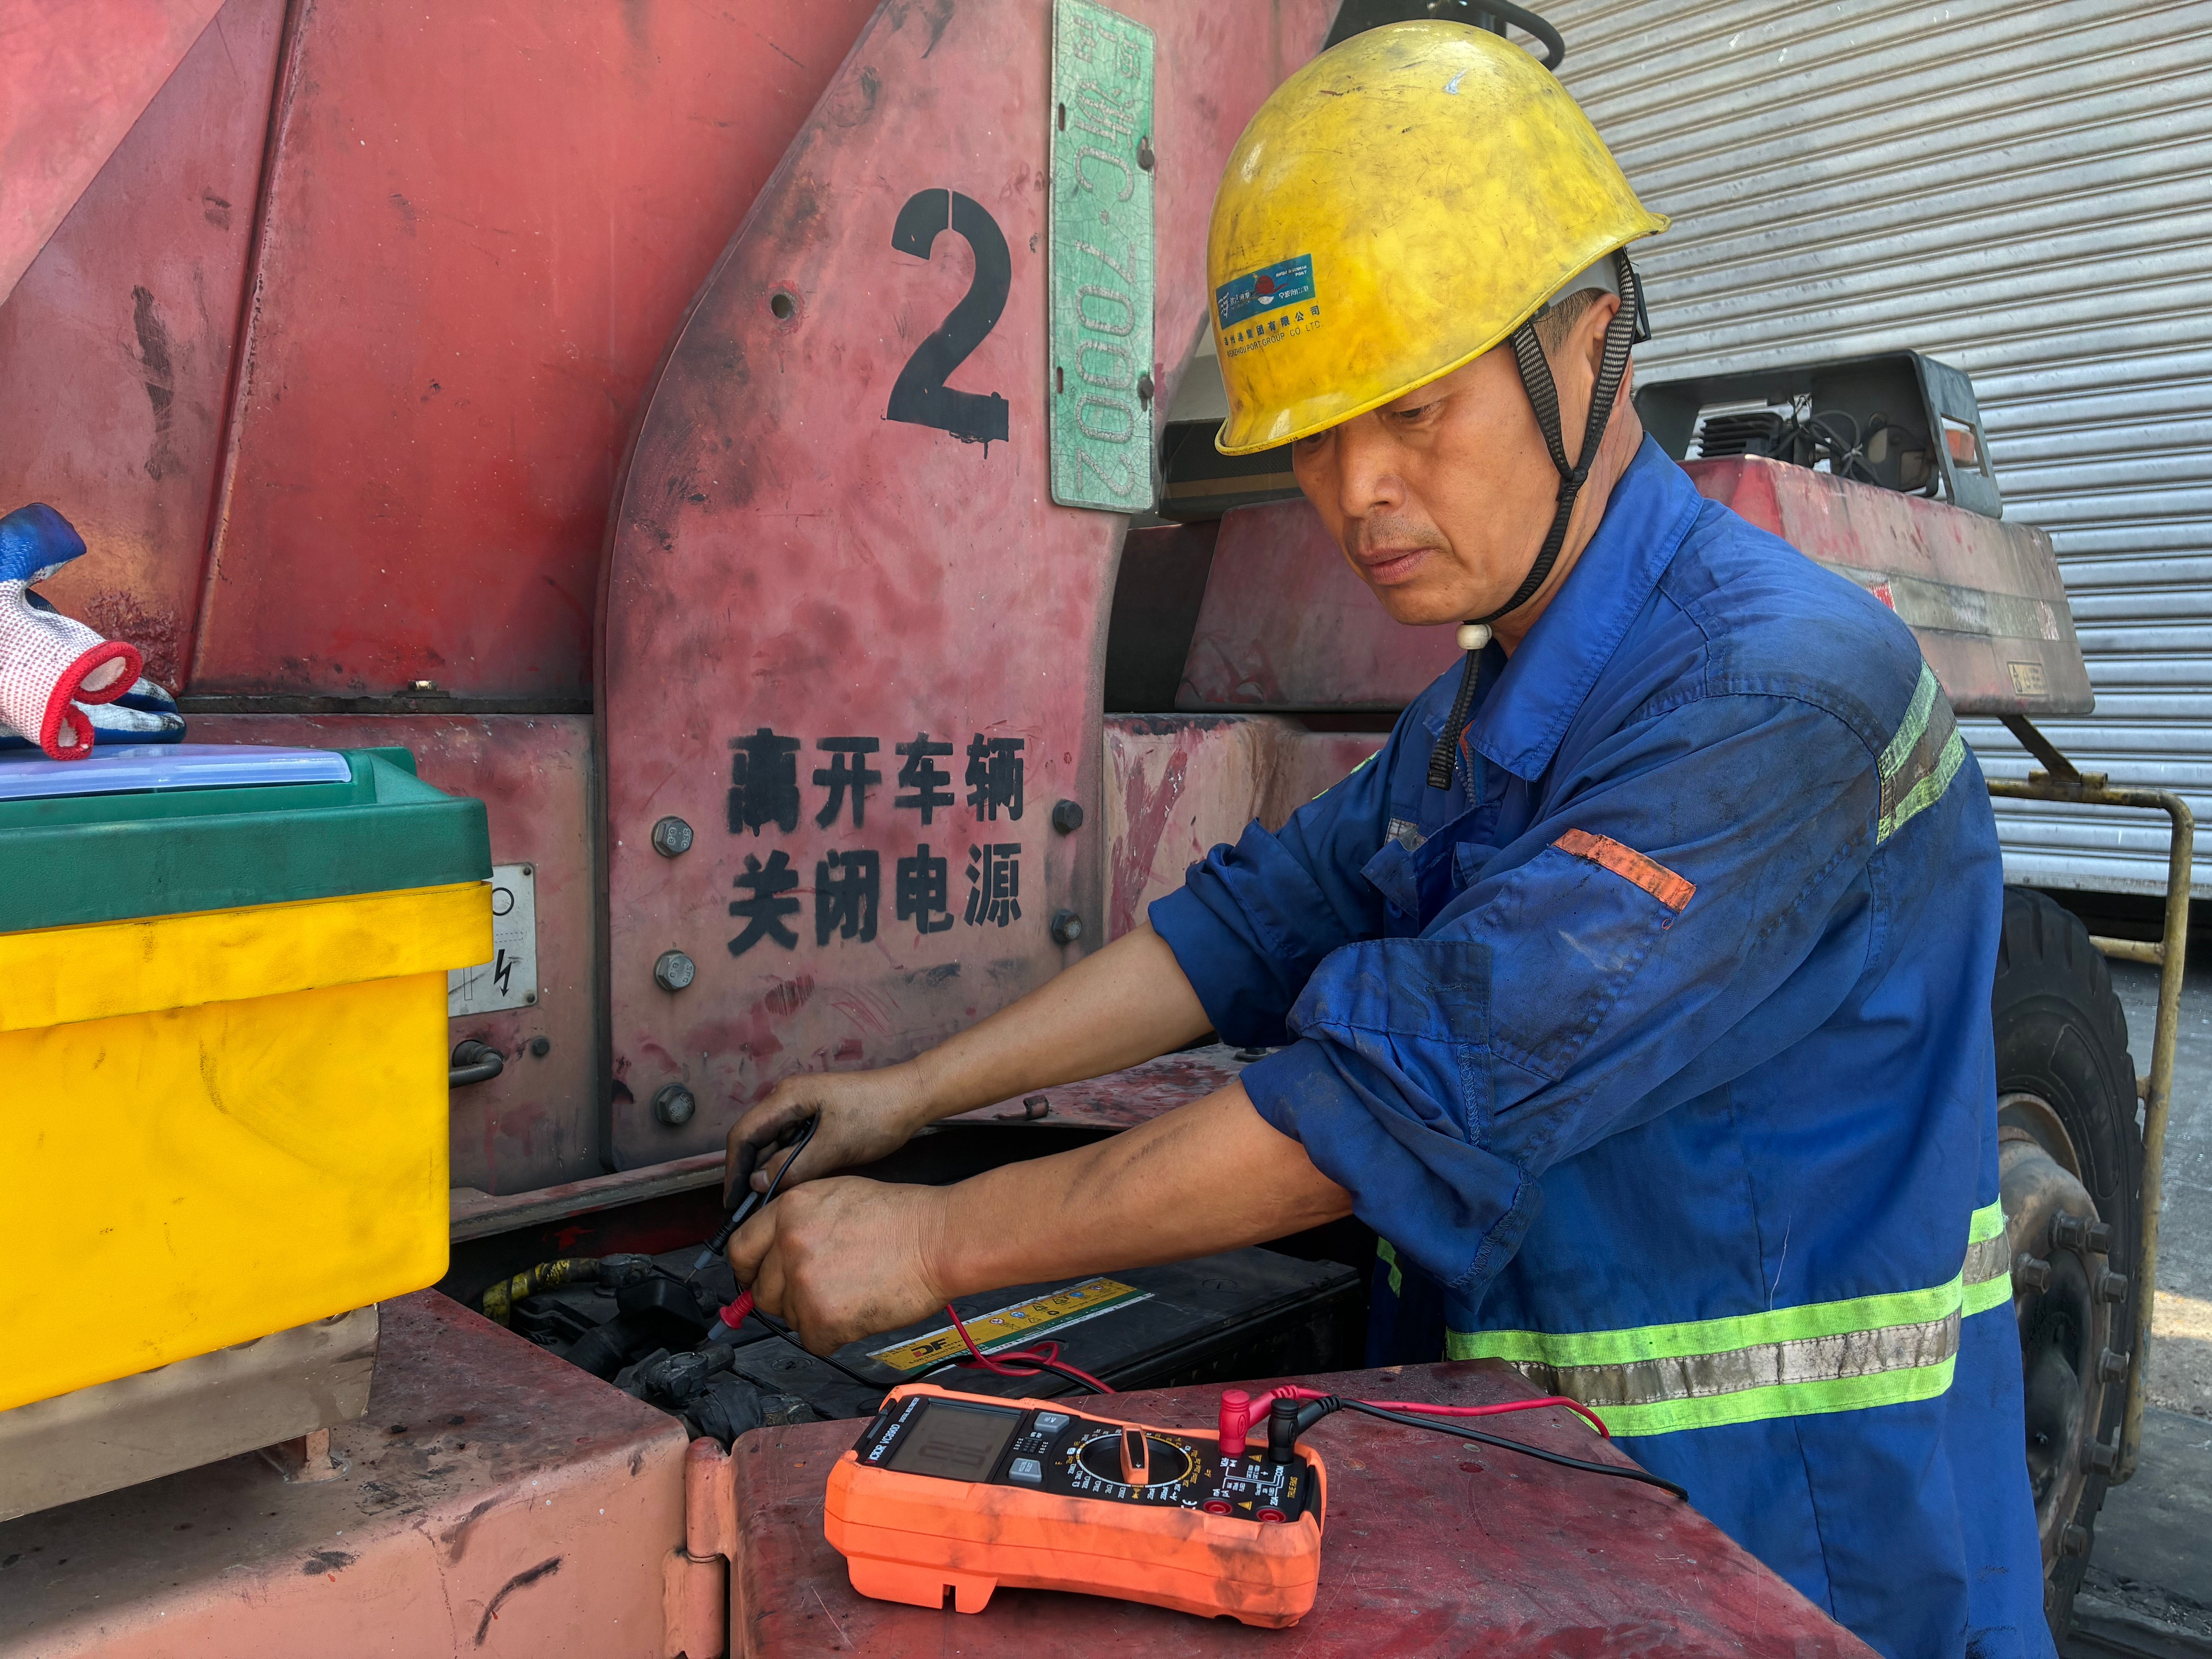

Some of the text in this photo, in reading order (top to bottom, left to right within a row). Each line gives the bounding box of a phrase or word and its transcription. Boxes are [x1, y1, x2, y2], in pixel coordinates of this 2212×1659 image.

[886, 188, 1012, 443] 2
[1247, 341, 1261, 351] PORT
[1262, 332, 1285, 346] GROUP
[1290, 327, 1300, 337] CO
[726, 727, 1025, 836] 离开车辆
[668, 827, 677, 845] 8.8
[681, 828, 691, 848] SFC
[727, 842, 1024, 958] 关闭电源
[910, 1338, 947, 1358] DF
[1274, 1465, 1285, 1476] COM
